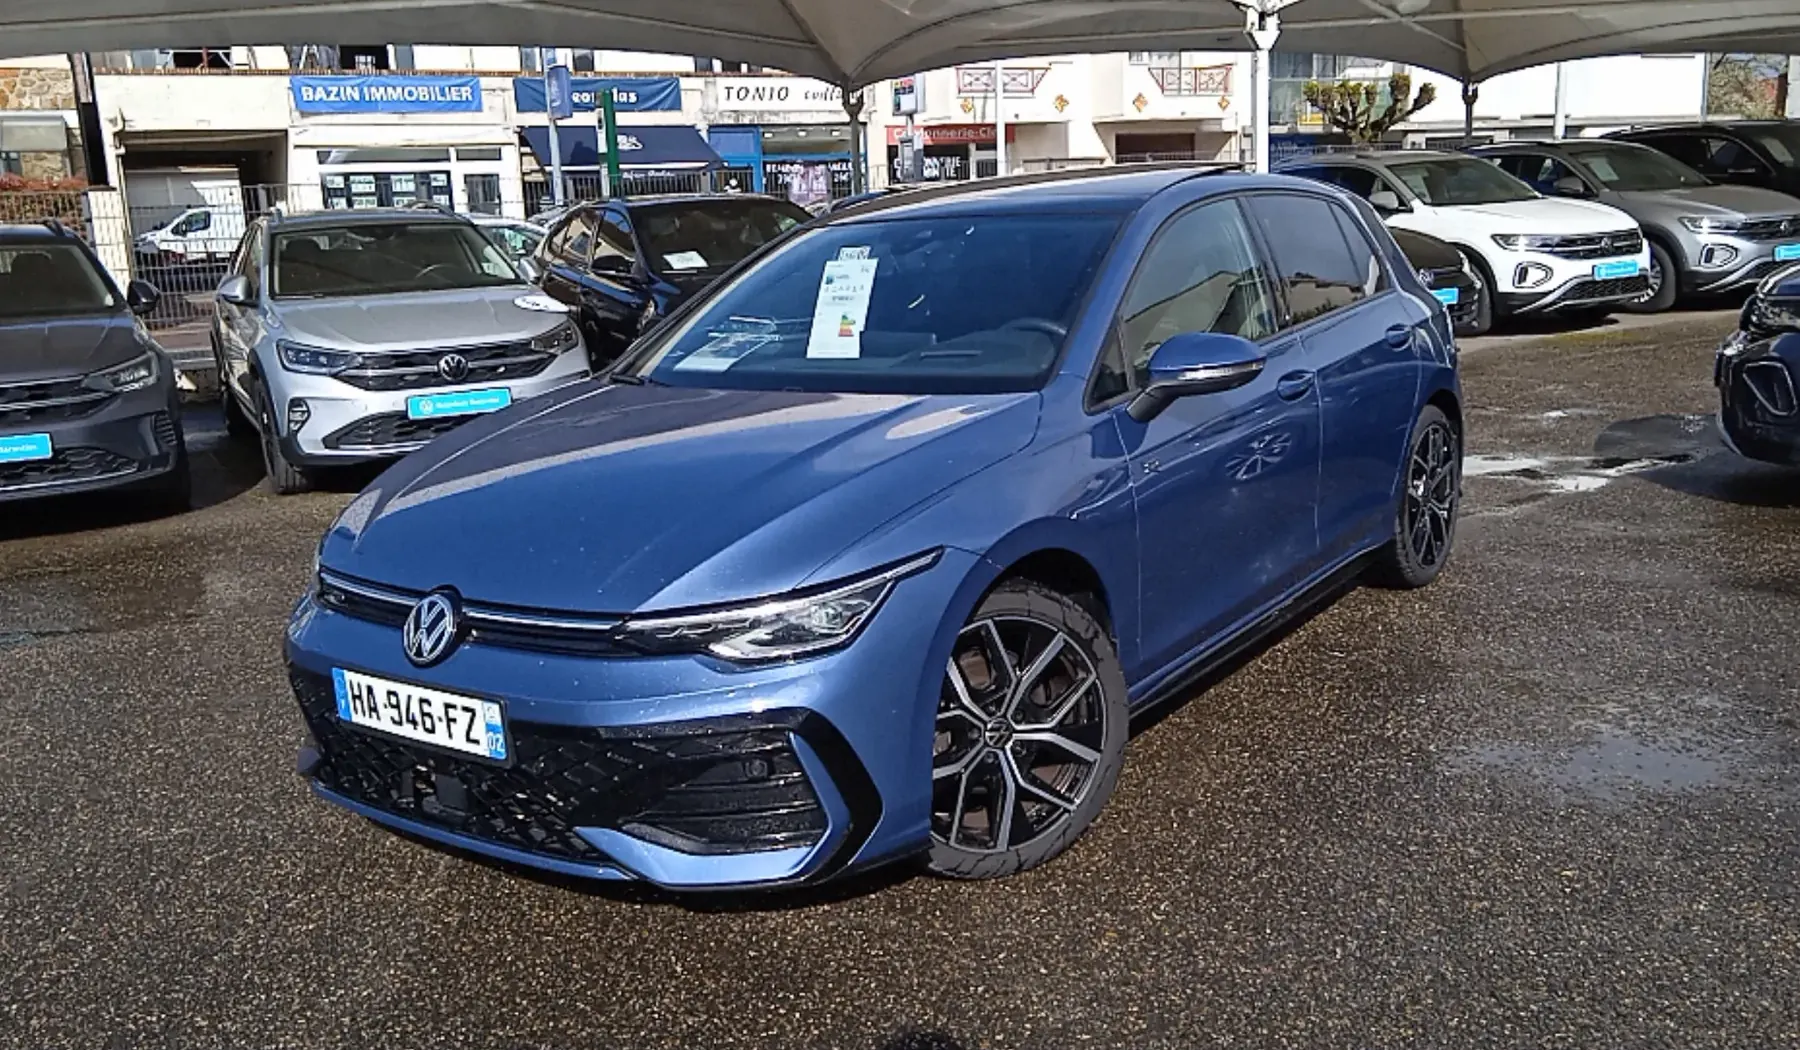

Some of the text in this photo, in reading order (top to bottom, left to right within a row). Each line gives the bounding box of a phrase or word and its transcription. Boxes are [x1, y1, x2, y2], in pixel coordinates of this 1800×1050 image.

[301, 86, 473, 101] BAZIN IMMOBILIER
[724, 86, 789, 101] TONIO
[349, 679, 481, 746] HA-946-FZ
[487, 732, 505, 751] 02
